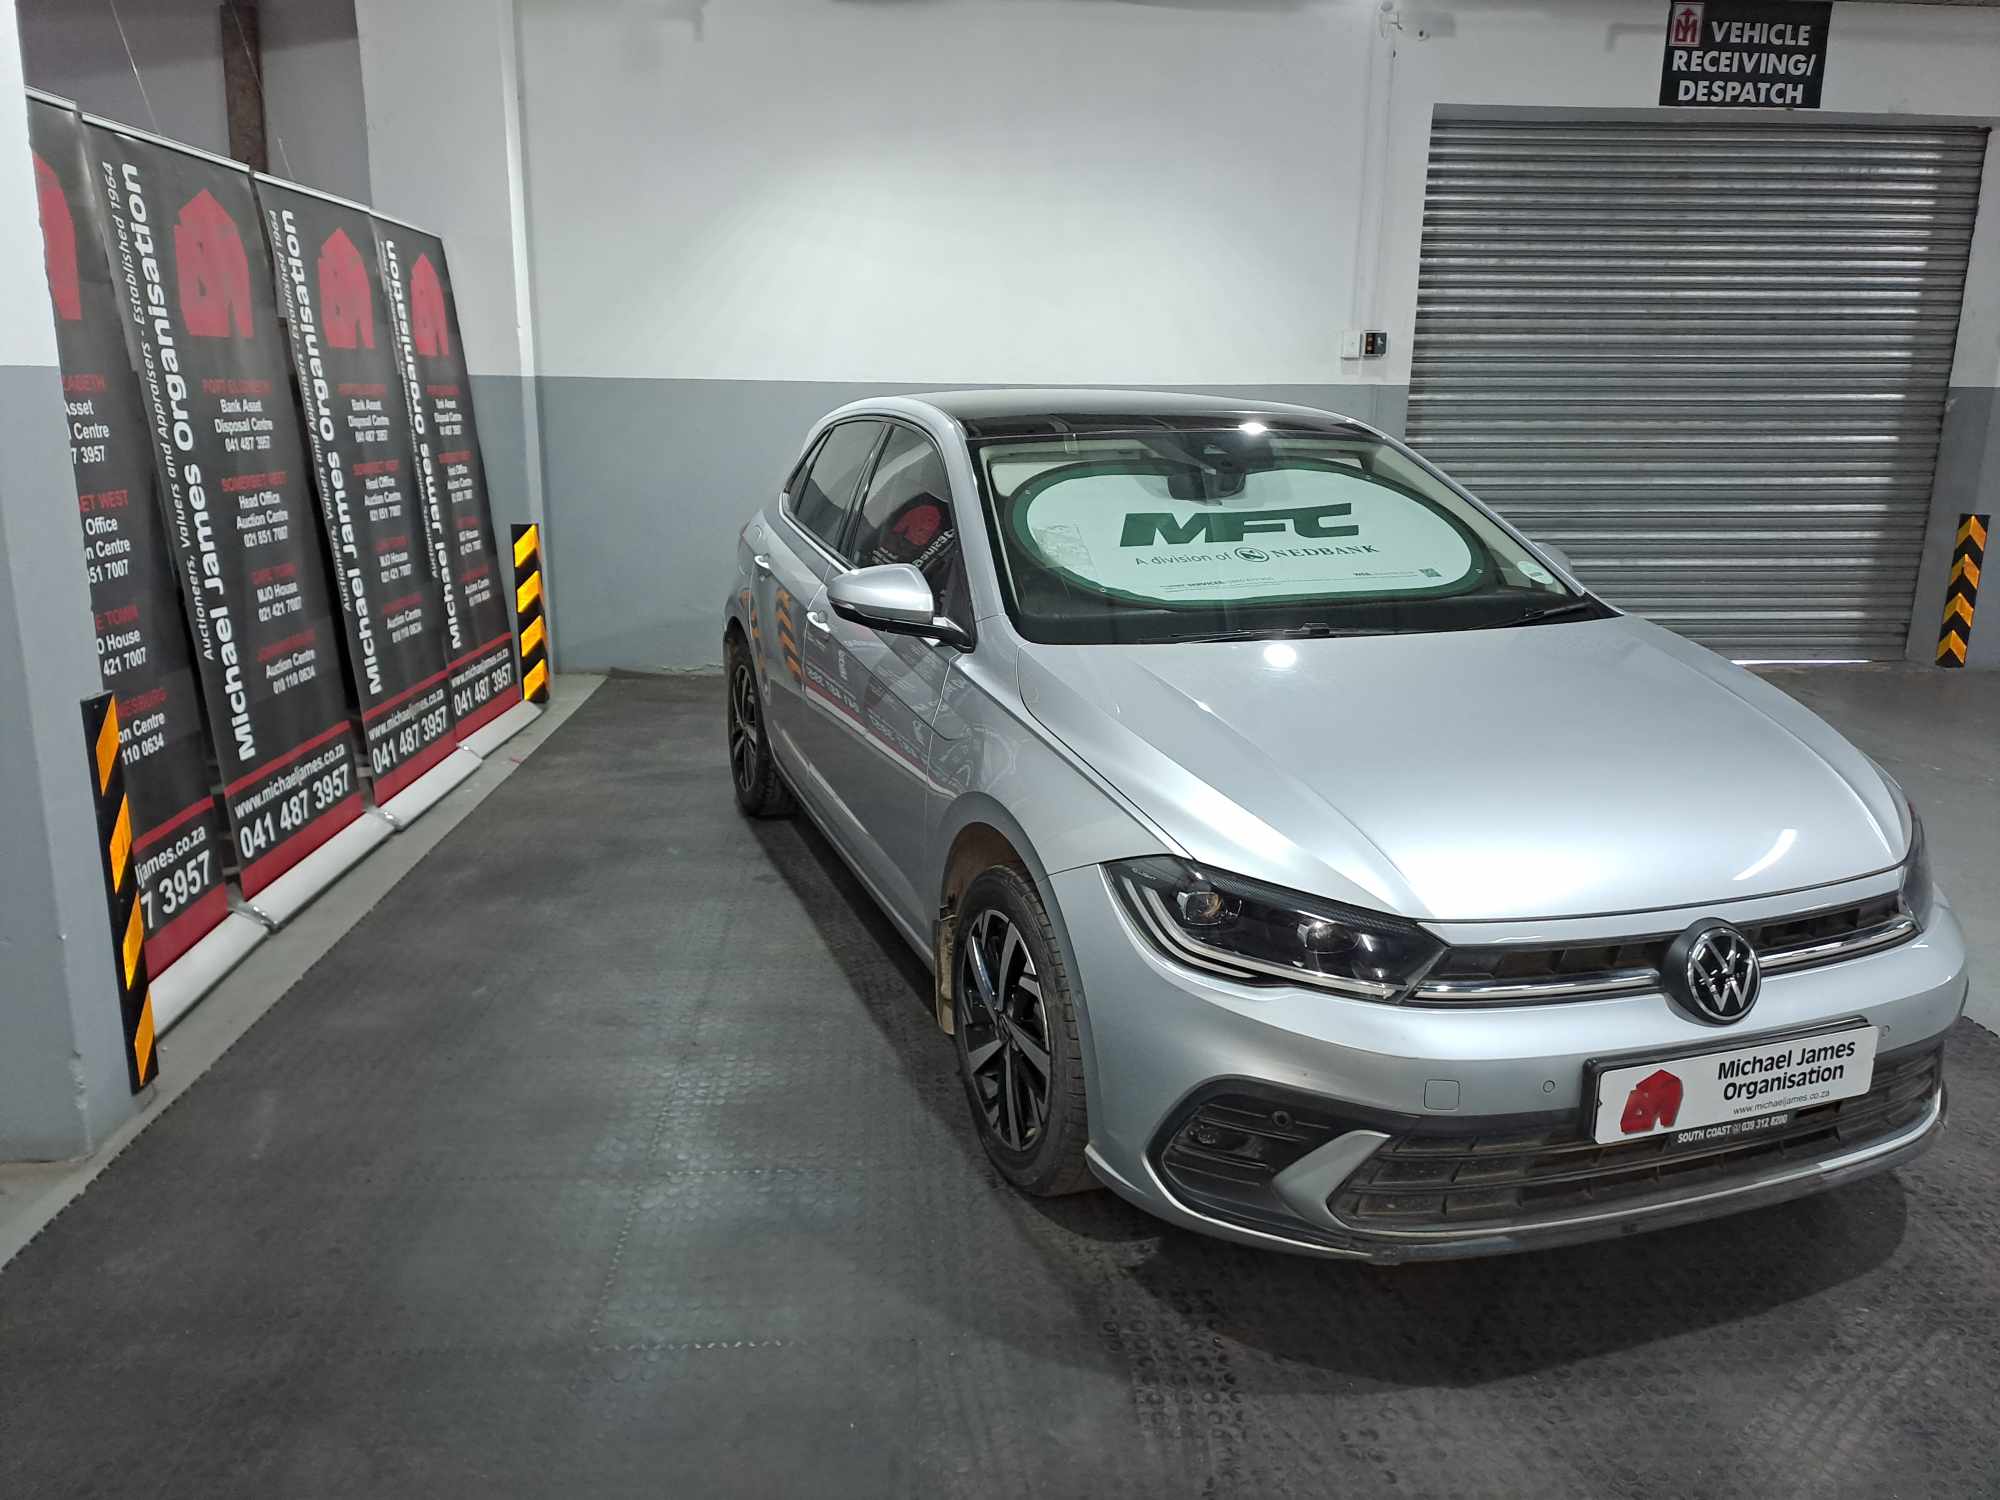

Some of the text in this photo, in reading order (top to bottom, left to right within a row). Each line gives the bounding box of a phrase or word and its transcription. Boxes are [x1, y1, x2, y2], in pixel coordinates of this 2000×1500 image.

[1711, 21, 1812, 47] VEHICLE
[1671, 50, 1817, 76] RECEIVING/
[1677, 80, 1804, 105] DESPATCH
[102, 161, 121, 210] 1964
[111, 215, 145, 325] Established
[386, 240, 425, 435] Organisation
[141, 342, 169, 439] Appraisers
[73, 422, 111, 439] Centre
[81, 445, 105, 464] 3957
[122, 163, 256, 761] Michael James Organisation
[160, 443, 177, 478] and
[282, 210, 382, 695] Michael James Organisation
[420, 443, 442, 534] James
[85, 516, 118, 535] Office
[171, 483, 191, 548] Valuers
[1119, 502, 1360, 548] MFC
[95, 539, 131, 557] Centre
[1135, 543, 1381, 566] A division of NEDBANK
[104, 559, 129, 579] 7007
[434, 542, 462, 649] Michael
[106, 629, 141, 652] House
[103, 647, 146, 677] 421 7007
[454, 663, 511, 716] 041 487 3957
[133, 713, 165, 736] Centre
[372, 705, 447, 774] 041 487 3957
[122, 732, 165, 766] 110 0634
[234, 743, 345, 819] www.michaeljames.co.za
[239, 763, 349, 859] 041 487 3957
[158, 850, 211, 914] 3957
[1717, 1041, 1856, 1081] Michael James
[1723, 1064, 1845, 1101] Organisation
[1677, 1130, 1705, 1144] SOUTH
[1705, 1124, 1732, 1139] COAST
